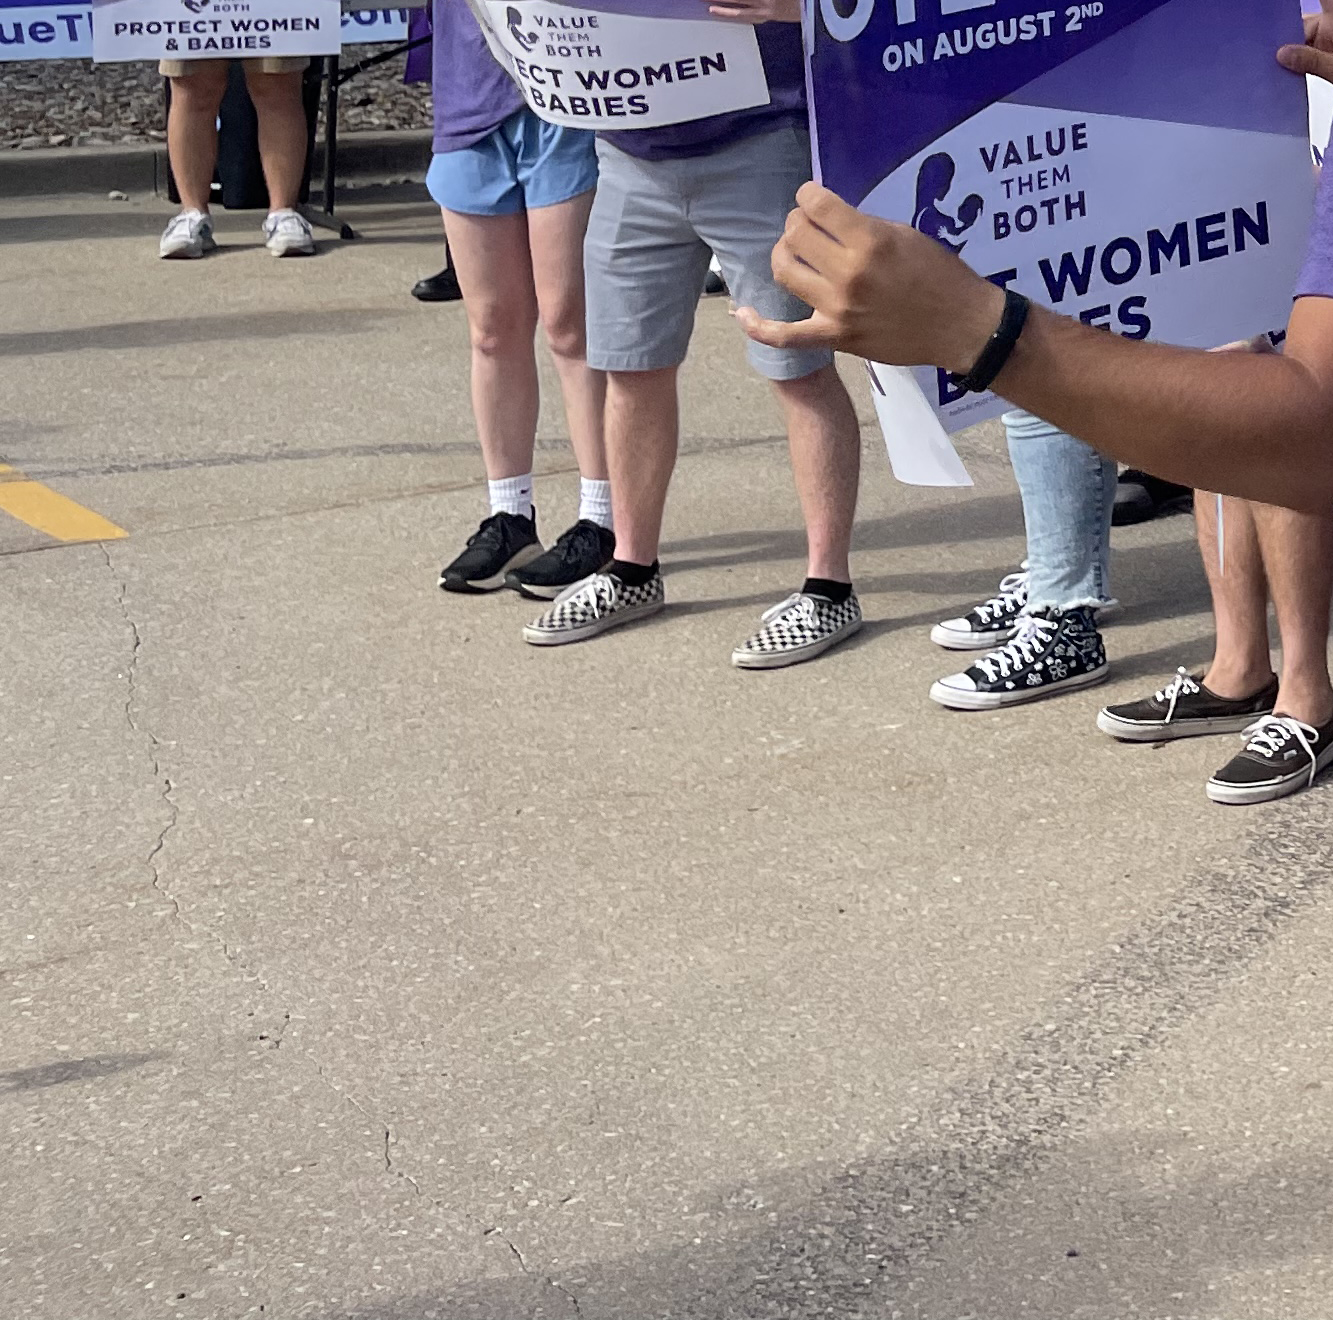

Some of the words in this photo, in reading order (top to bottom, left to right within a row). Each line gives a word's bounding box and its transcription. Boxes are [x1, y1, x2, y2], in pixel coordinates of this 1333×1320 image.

[213, 4, 250, 12] BOTH
[533, 15, 599, 28] VALUE
[114, 20, 222, 36] PROTECT
[230, 17, 320, 32] WOMEN
[547, 33, 590, 42] THEM
[882, 37, 924, 72] ON
[933, 10, 1055, 62] AUGUST
[1065, 1, 1104, 32] 2ND
[165, 38, 178, 51] &
[188, 35, 271, 50] BABIES
[546, 44, 602, 57] BOTH
[575, 53, 727, 91] WOMEN
[530, 86, 650, 117] BABIES
[980, 122, 1088, 173] VALUE
[1000, 164, 1071, 200] THEM
[993, 190, 1087, 241] BOTH
[1038, 201, 1270, 303] WOMEN
